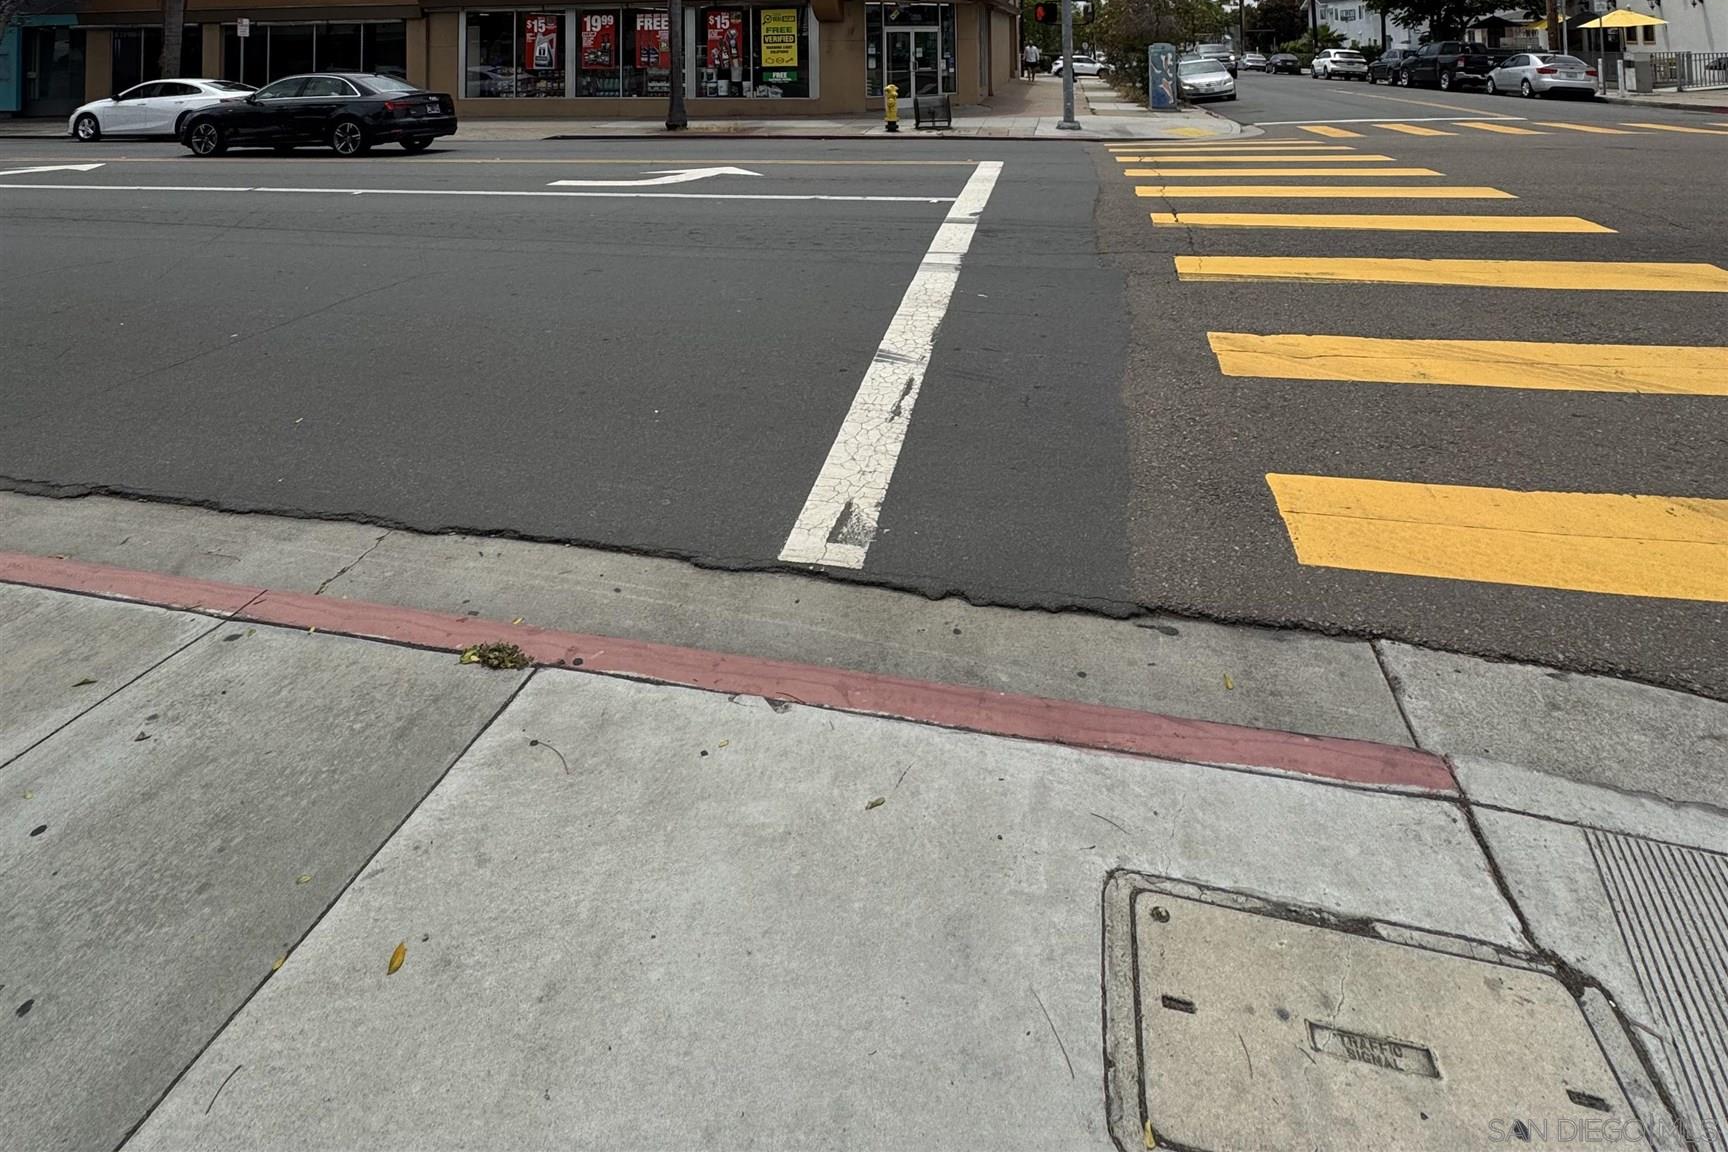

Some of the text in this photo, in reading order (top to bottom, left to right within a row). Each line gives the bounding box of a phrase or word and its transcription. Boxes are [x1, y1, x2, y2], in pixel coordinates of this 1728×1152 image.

[526, 19, 546, 33] $15
[636, 16, 669, 30] FREE
[708, 15, 730, 29] $15
[764, 35, 795, 43] VERIFIED
[1345, 1047, 1405, 1072] SIGNAL
